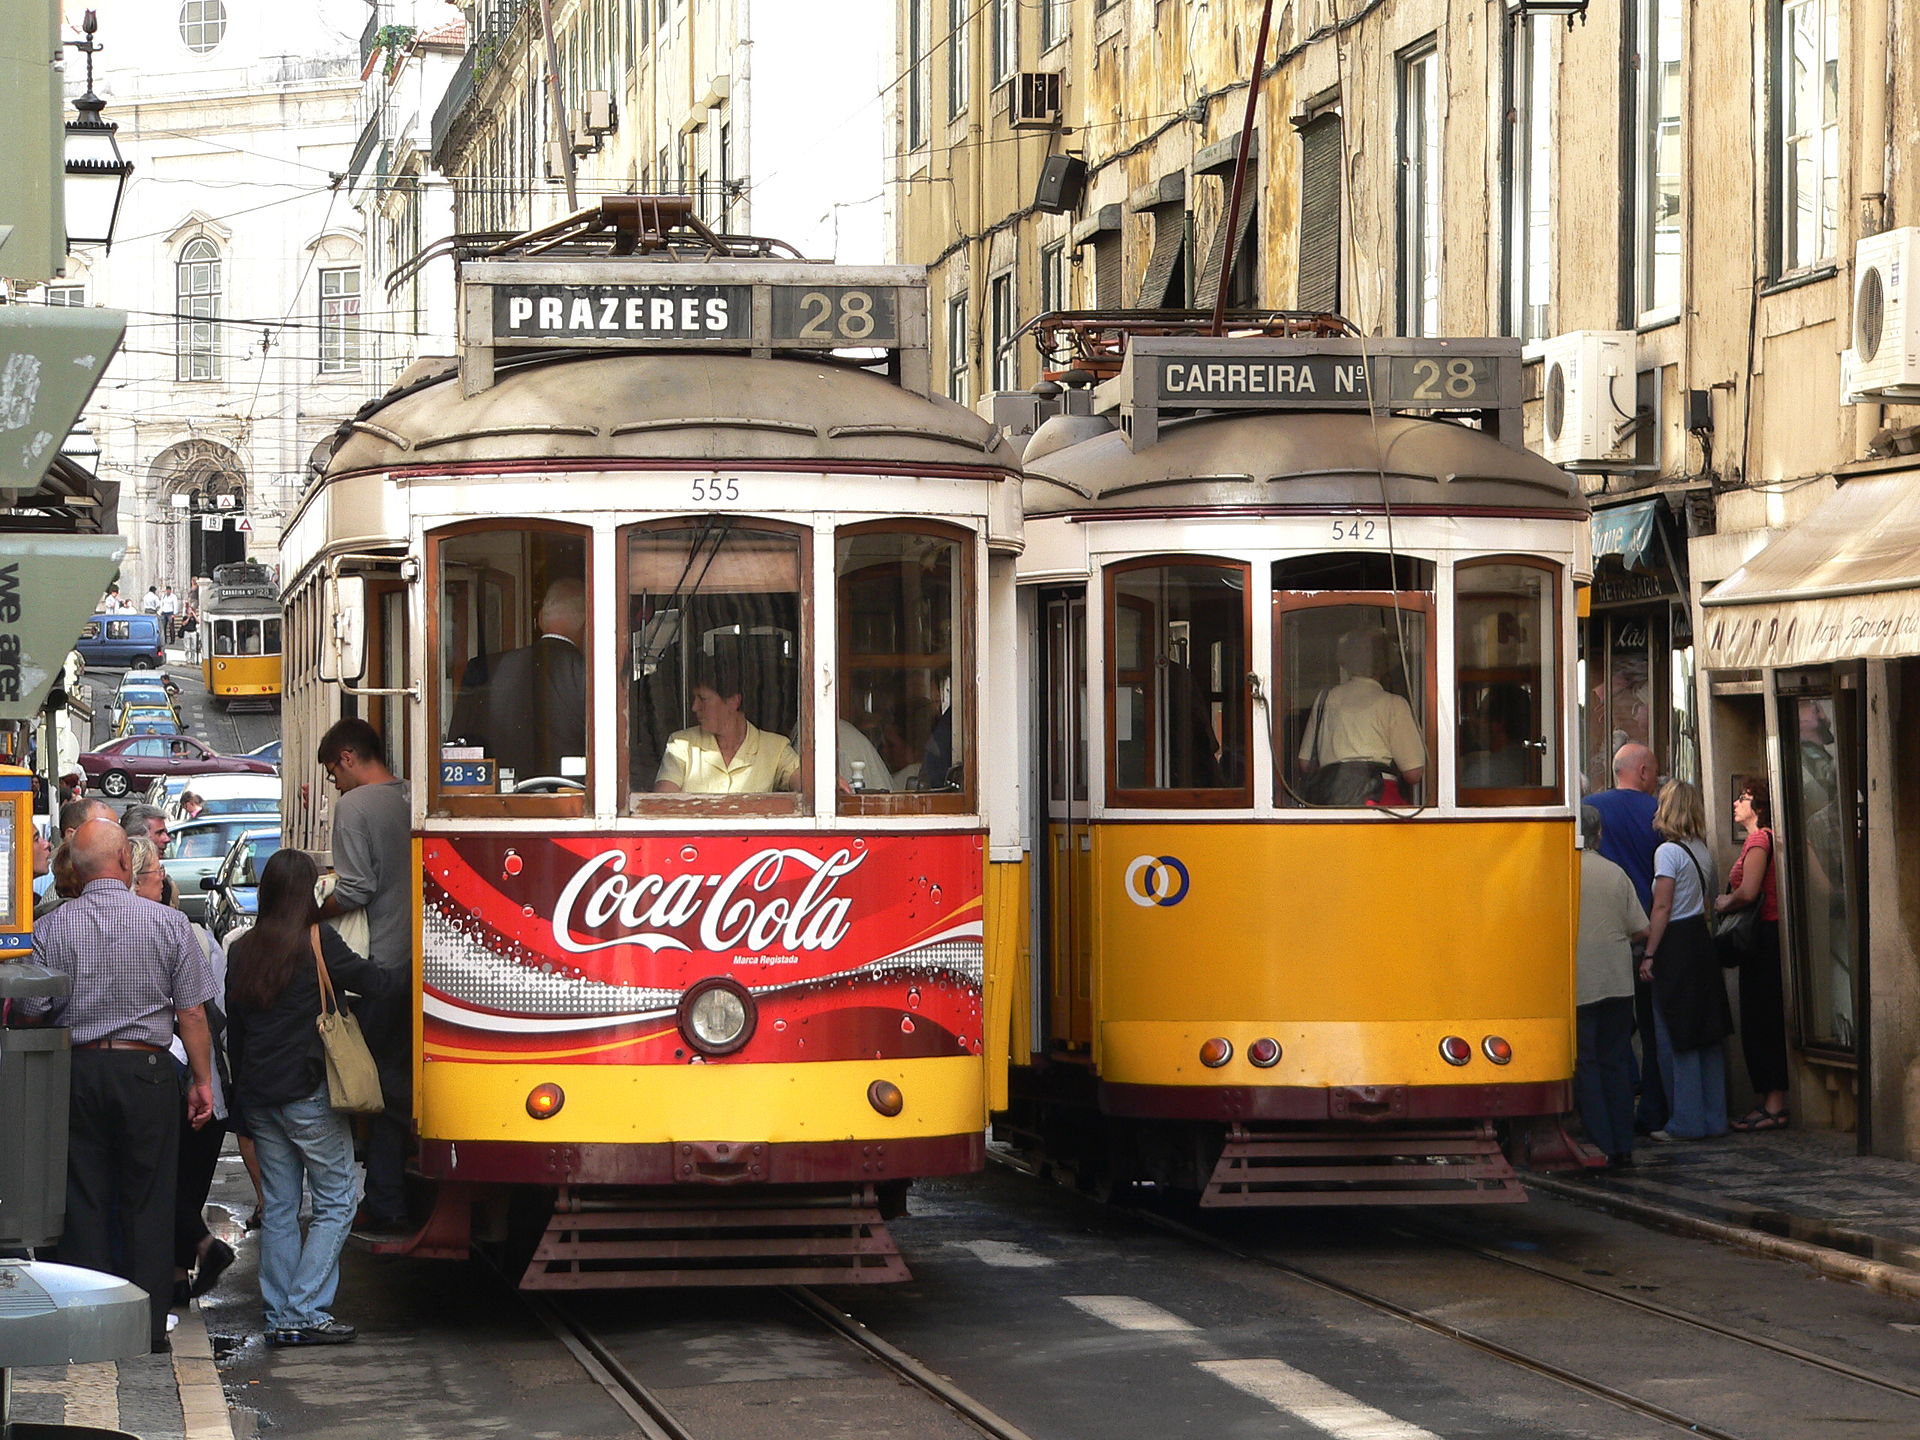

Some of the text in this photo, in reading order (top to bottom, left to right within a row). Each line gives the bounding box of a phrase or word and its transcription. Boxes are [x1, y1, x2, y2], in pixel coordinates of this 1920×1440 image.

[509, 291, 875, 339] PRAZERES 28
[1166, 364, 1316, 393] CARREIRA
[1413, 358, 1475, 400] 28
[692, 478, 739, 501] 555
[1332, 520, 1375, 540] 542
[1846, 615, 1892, 640] Raos
[552, 849, 868, 953] Coca-Cola
[733, 955, 799, 966] Marca Registada
